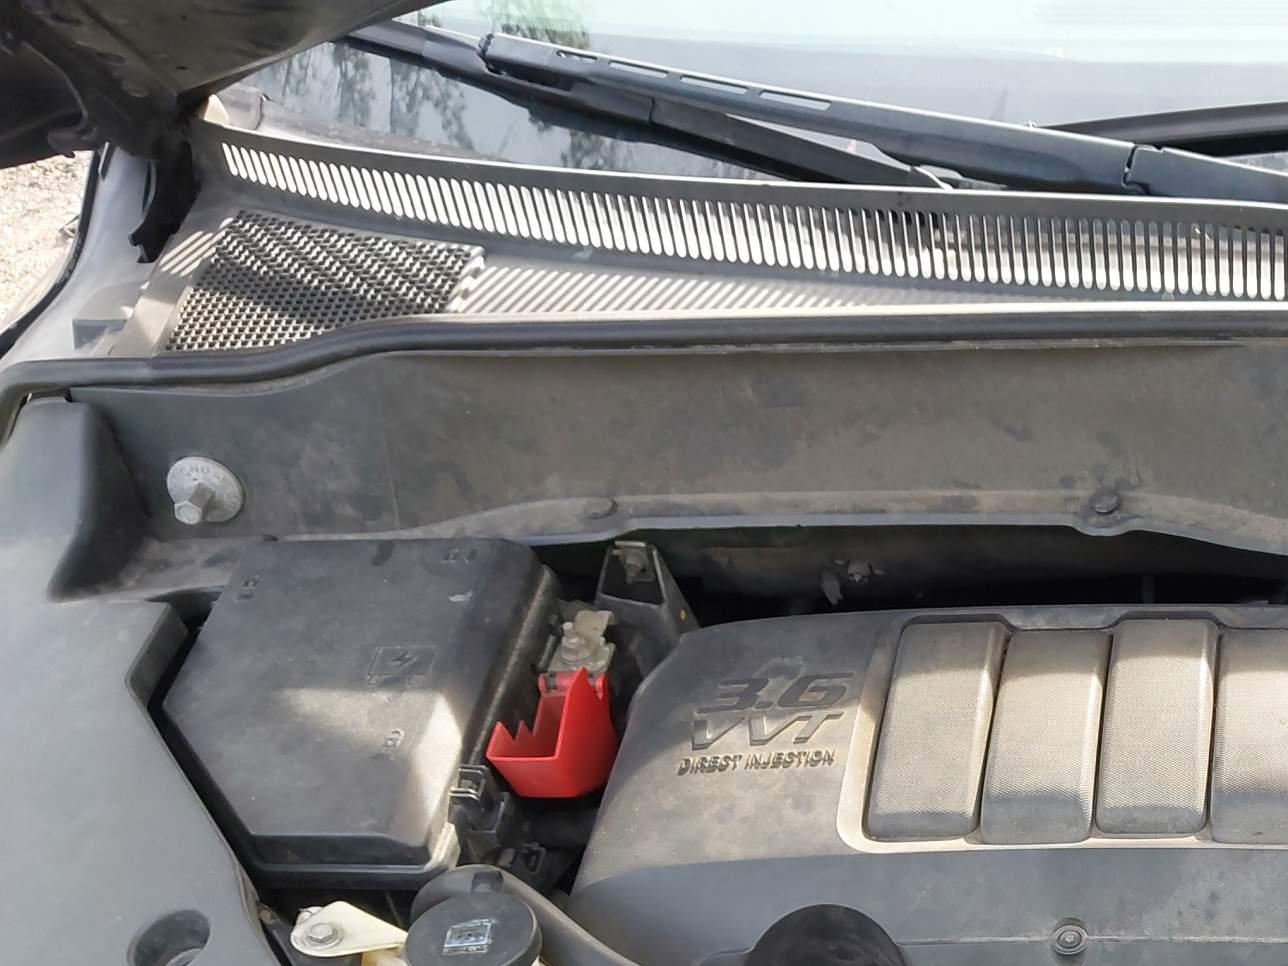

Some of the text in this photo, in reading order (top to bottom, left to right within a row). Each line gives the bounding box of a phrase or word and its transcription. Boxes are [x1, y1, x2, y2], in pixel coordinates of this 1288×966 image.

[694, 672, 854, 714] 3.6
[691, 711, 845, 751] VVT
[678, 750, 836, 776] DIRECT INJECTION
